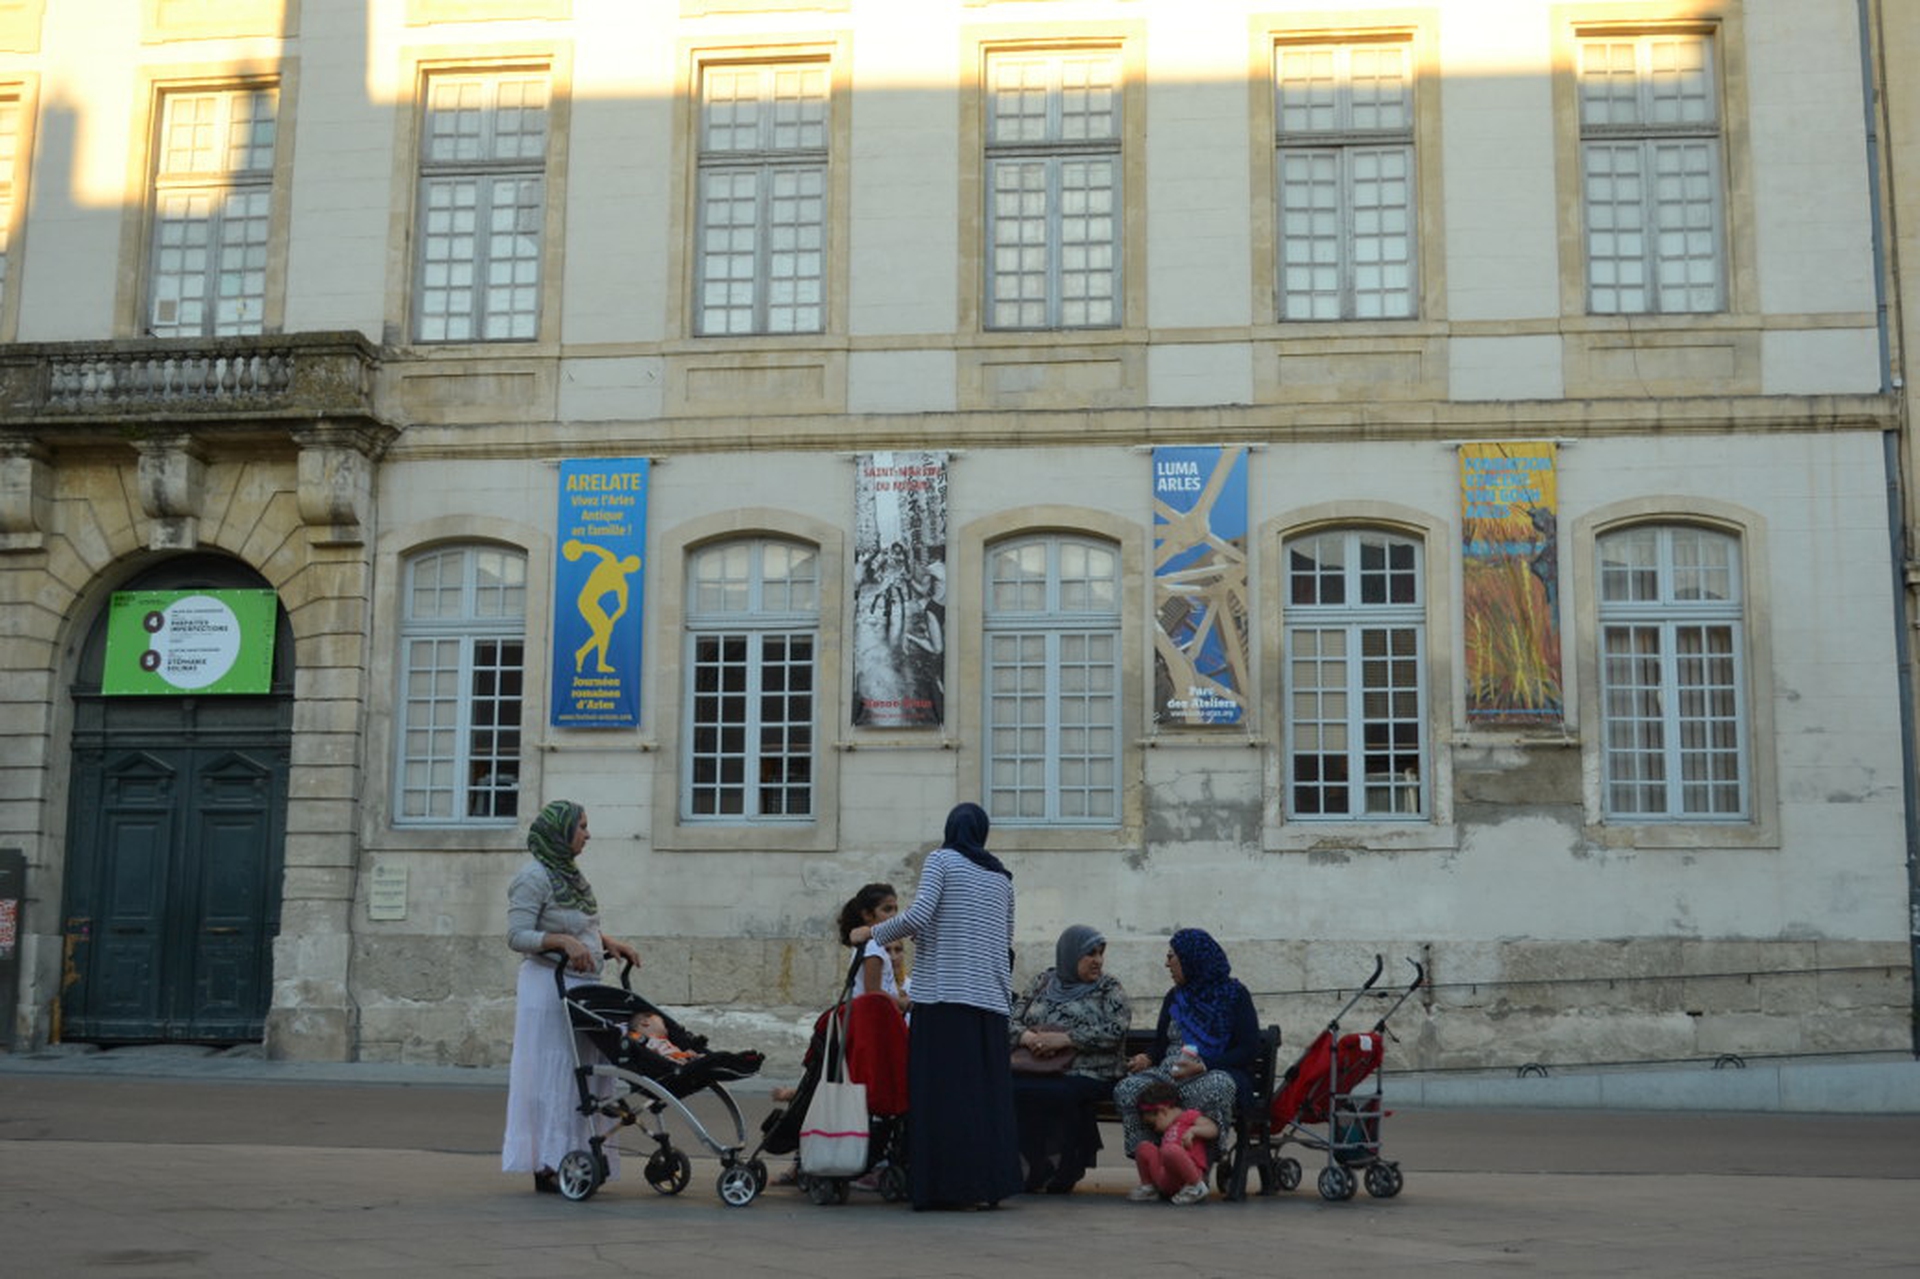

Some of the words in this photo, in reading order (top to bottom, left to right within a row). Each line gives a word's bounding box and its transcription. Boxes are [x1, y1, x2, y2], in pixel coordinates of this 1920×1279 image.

[1157, 462, 1198, 475] LUMA
[566, 473, 641, 491] ARELATE
[1157, 477, 1201, 491] ARLES
[581, 509, 623, 521] Antique
[572, 527, 585, 536] en
[149, 616, 159, 627] 4
[576, 699, 615, 710] d'Arles
